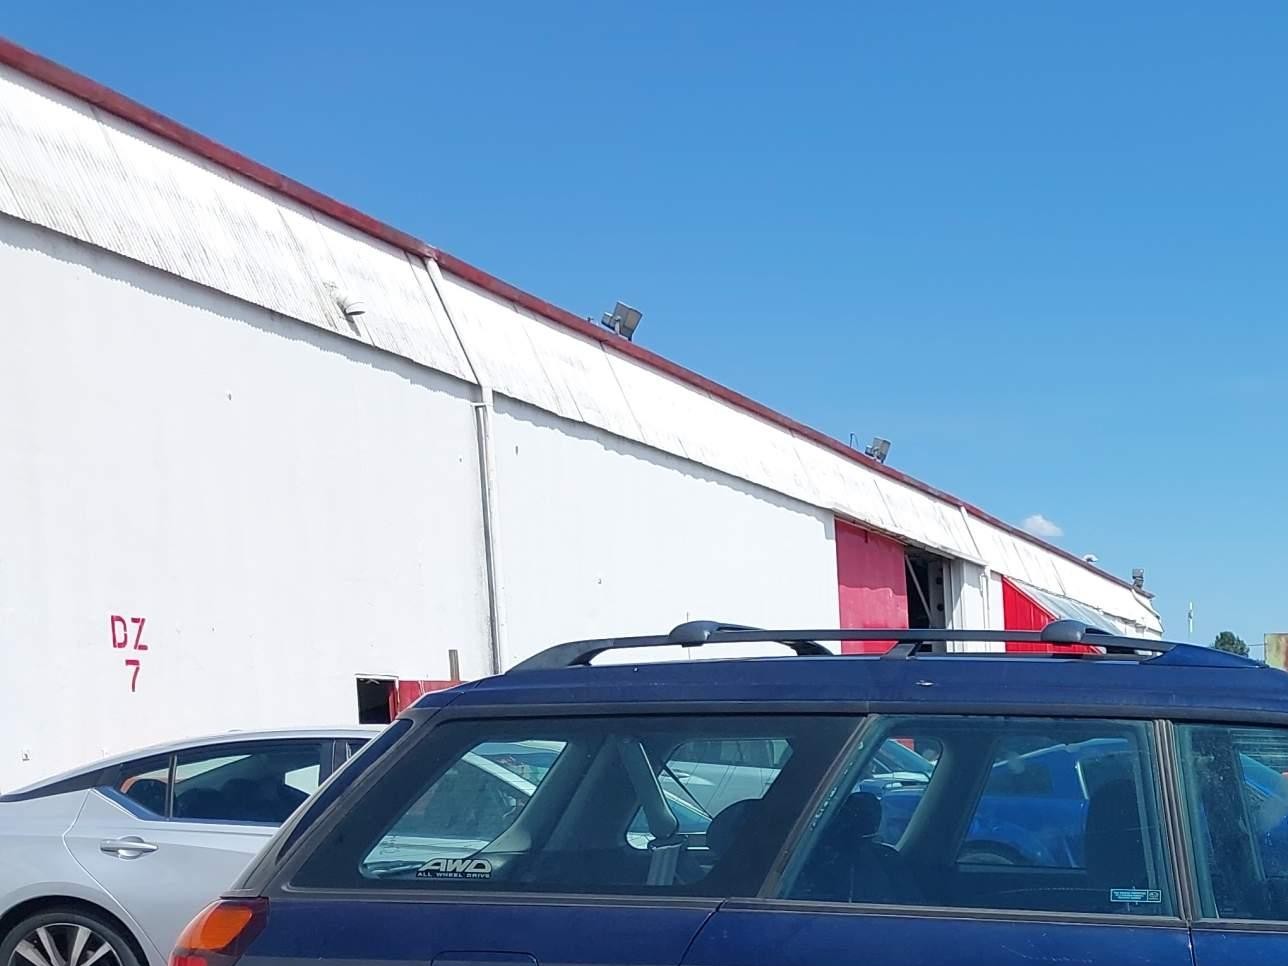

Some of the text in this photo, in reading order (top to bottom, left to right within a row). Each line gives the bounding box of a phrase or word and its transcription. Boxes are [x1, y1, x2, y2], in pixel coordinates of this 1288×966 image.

[110, 615, 149, 651] DZ
[125, 659, 140, 693] 7
[417, 859, 493, 873] AWD
